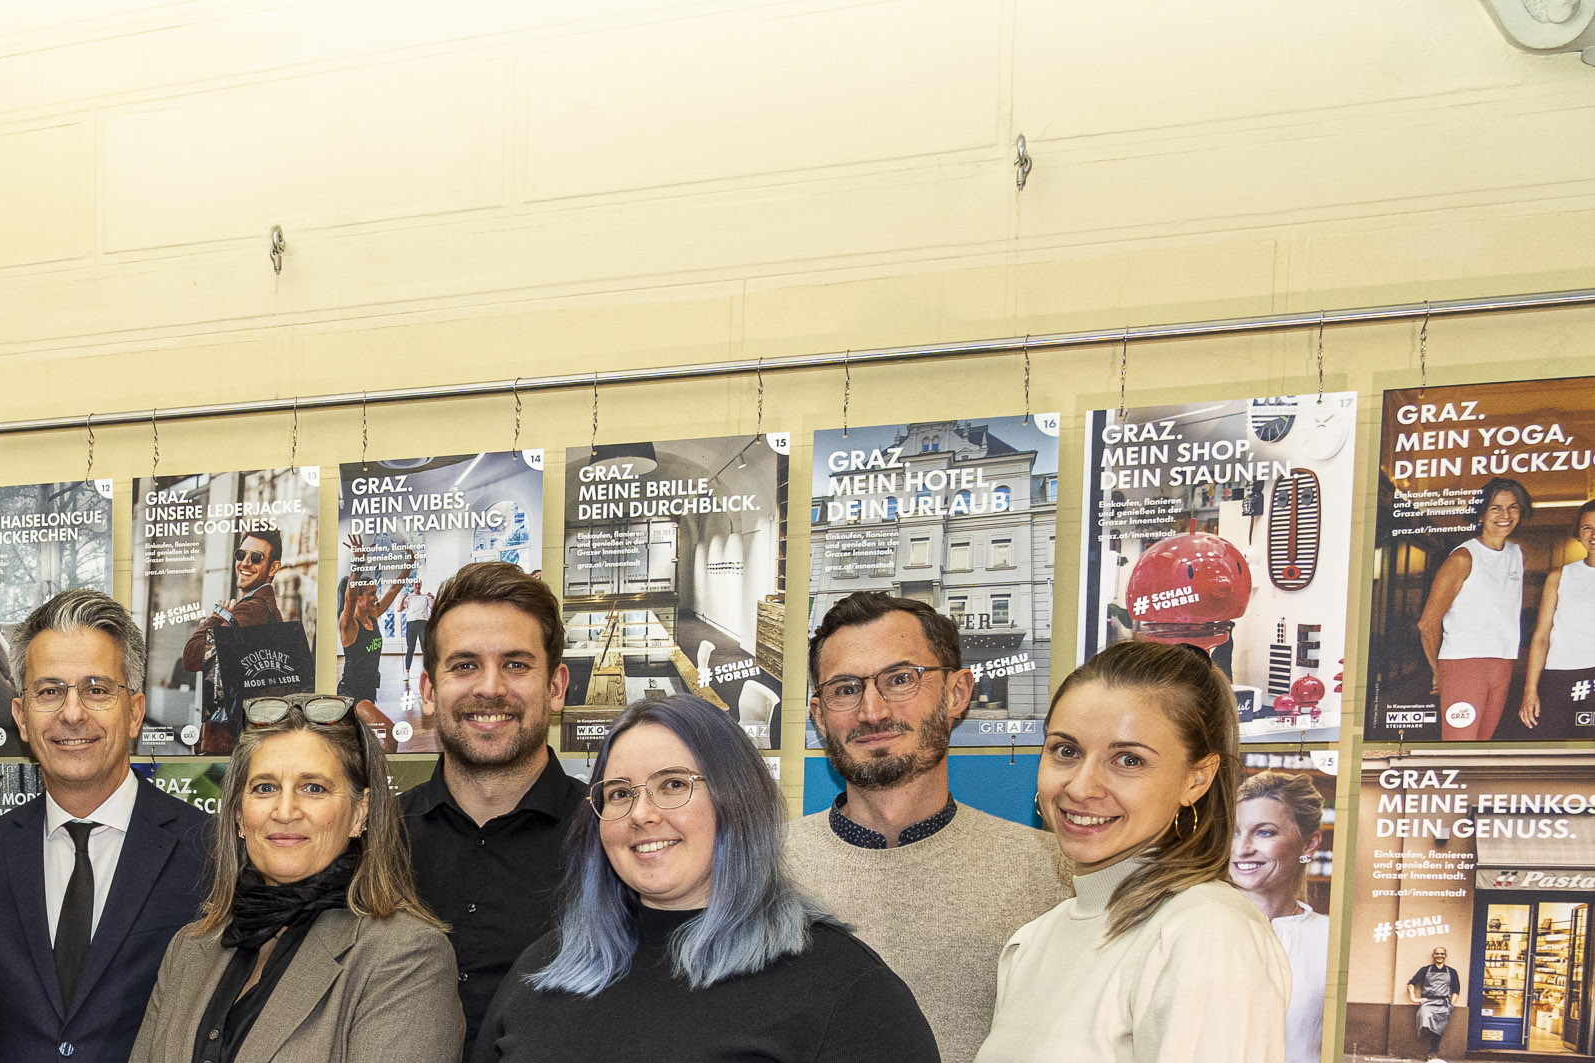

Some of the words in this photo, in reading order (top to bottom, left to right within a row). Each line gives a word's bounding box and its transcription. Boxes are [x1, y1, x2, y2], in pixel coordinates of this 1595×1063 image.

[1338, 398, 1353, 408] 17
[1396, 401, 1485, 425] GRAZ.
[1044, 420, 1056, 429] 16
[1102, 421, 1182, 445] GRAZ.
[776, 439, 786, 447] 15
[1395, 428, 1469, 453] MEIN
[1478, 424, 1574, 446] YOGA,
[530, 455, 541, 463] 14
[828, 448, 911, 472] GRAZ.
[1101, 444, 1168, 467] MEIN
[1177, 439, 1255, 463] SHOP,
[579, 464, 639, 482] GRAZ.
[1395, 457, 1462, 479] DEIN
[1471, 449, 1595, 476] RÜCKZU
[307, 472, 317, 480] 13
[828, 473, 897, 496] MEIN
[905, 468, 995, 492] HOTEL,
[1100, 469, 1160, 490] DEIN
[1169, 460, 1299, 486] STAUNEN.
[352, 475, 413, 495] GRAZ.
[579, 484, 640, 501] MEINE
[646, 478, 713, 497] BRILLE,
[1394, 490, 1441, 499] Einkaufen,
[1443, 488, 1483, 496] flanieren
[145, 490, 193, 505] GRAZ.
[352, 496, 403, 515] MEIN
[409, 492, 471, 512] VIBES,
[828, 499, 889, 521] DEIN
[897, 492, 1014, 518] URLAUB.
[1394, 499, 1410, 508] und
[1413, 498, 1455, 507] genießen
[1457, 497, 1465, 505] in
[1468, 497, 1484, 505] der
[145, 505, 202, 521] UNSERE
[207, 500, 306, 518] LEDERJACKE,
[579, 502, 625, 520] DEIN
[630, 495, 761, 516] DURCHBLICK.
[1393, 509, 1424, 517] Grazer
[1426, 507, 1477, 516] Innenstadt.
[145, 522, 189, 537] DEINE
[194, 517, 281, 534] COOLNESS.
[352, 516, 396, 535] DEIN
[403, 510, 508, 532] TRAINING.
[1392, 524, 1476, 536] graz.at/innenstadt
[1152, 593, 1200, 611] VORBEI
[241, 649, 290, 670] STOICHART
[254, 660, 281, 671] LEDER
[715, 667, 760, 684] VORBEI
[986, 661, 1036, 679] VORBEI
[244, 679, 265, 688] MODE
[279, 675, 300, 684] LEDER
[980, 722, 1033, 732] GRAZ
[1379, 769, 1467, 789] GRAZ.
[1377, 794, 1469, 814] MEINE
[1376, 818, 1444, 838] DEIN
[1452, 818, 1577, 838] GENUSS.
[1374, 850, 1426, 860] Einkaufen,
[1428, 850, 1473, 859] flanieren
[1374, 860, 1392, 869] und
[1396, 861, 1442, 871] genießen
[1444, 861, 1454, 869] in
[1457, 861, 1475, 870] der
[1373, 871, 1407, 880] Grazer
[1410, 871, 1466, 881] Innenstadt.
[1372, 888, 1467, 898] graz.at/innenstadt
[1396, 924, 1449, 940] VORBEI
